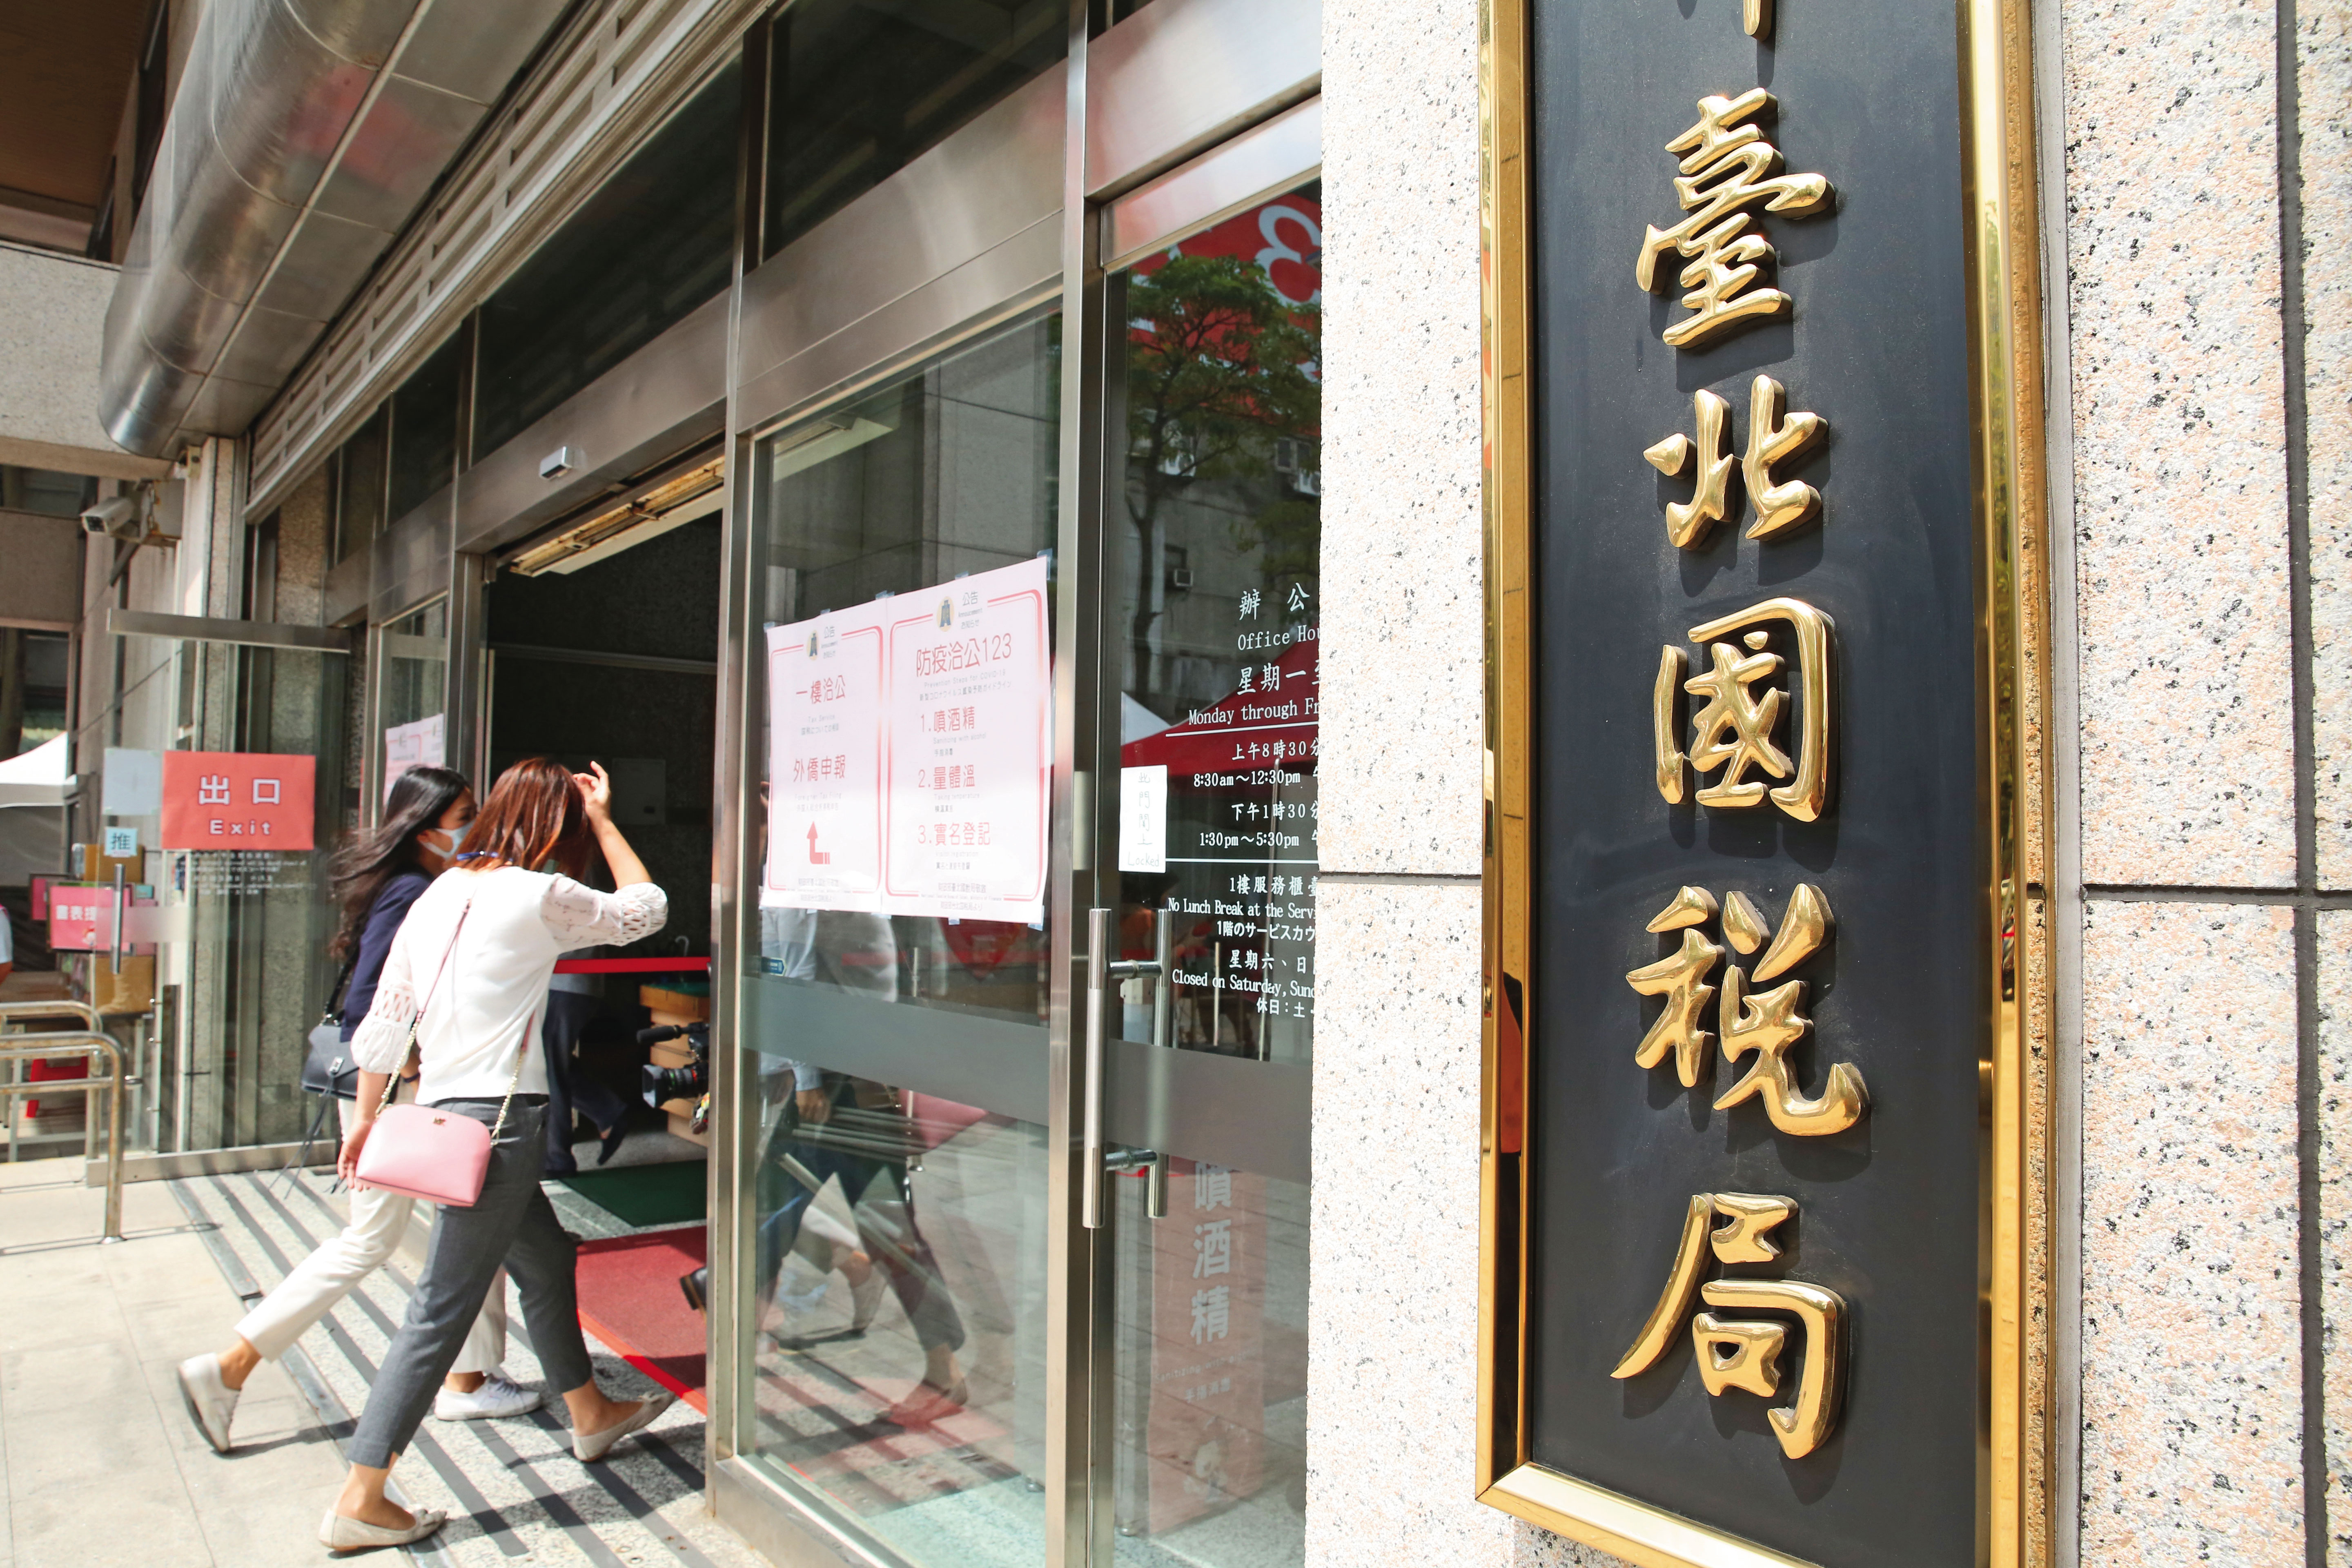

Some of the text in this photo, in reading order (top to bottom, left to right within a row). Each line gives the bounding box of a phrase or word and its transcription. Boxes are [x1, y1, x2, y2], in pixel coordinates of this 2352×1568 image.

[962, 591, 978, 606] 公告
[1238, 630, 1290, 650] Office
[916, 633, 1011, 677] 防疫洽公123
[796, 675, 846, 704] 一樓洽公
[1189, 707, 1234, 725] Monday
[1241, 699, 1298, 720] through
[1610, 0, 1863, 1460] 臺北國稅局
[793, 754, 846, 783] 外僑申報
[199, 774, 281, 805] 出口
[209, 819, 271, 835] Exit
[110, 832, 131, 850] 推
[1128, 851, 1160, 867] Locked
[1168, 897, 1180, 912] No
[1183, 898, 1211, 914] Lunch
[1214, 899, 1244, 916] Break
[1247, 903, 1261, 917] at
[1265, 902, 1283, 918] the
[1217, 920, 1316, 942] 1階のサービスカウ
[1229, 949, 1315, 975] 星期六、日
[1172, 969, 1208, 987] Closed
[1212, 976, 1225, 989] on
[1229, 973, 1287, 998] Saturday,
[1190, 1163, 1232, 1345] 噴酒精
